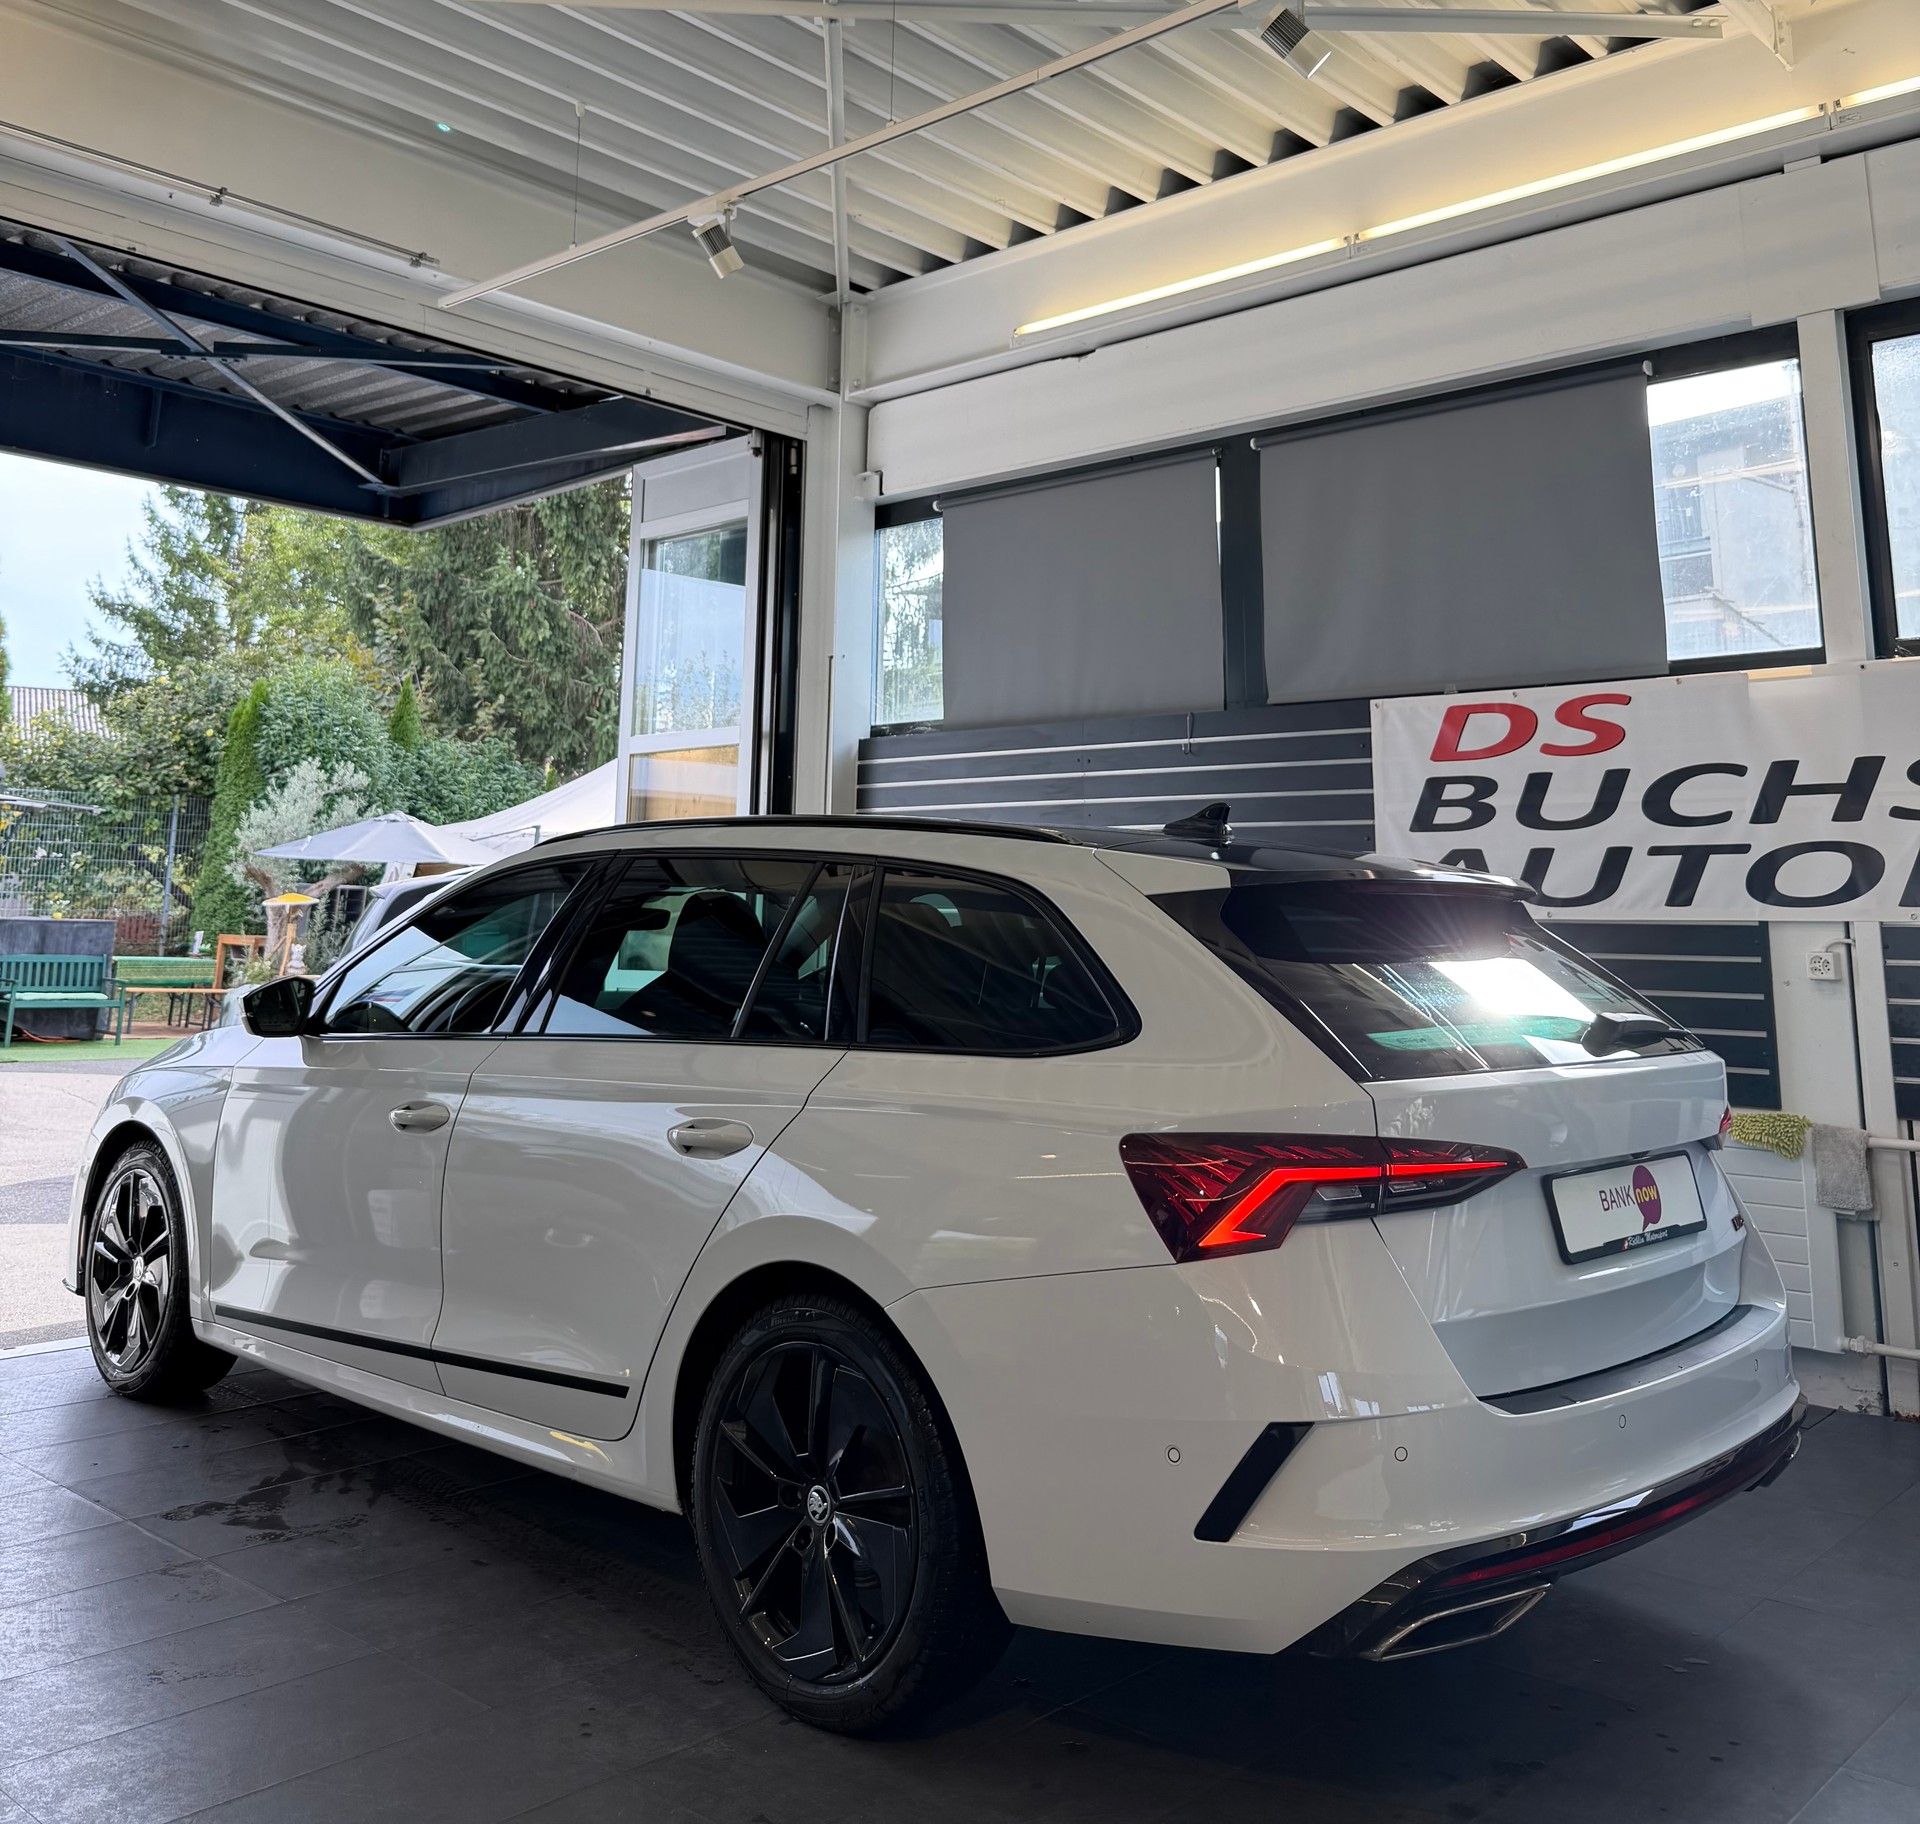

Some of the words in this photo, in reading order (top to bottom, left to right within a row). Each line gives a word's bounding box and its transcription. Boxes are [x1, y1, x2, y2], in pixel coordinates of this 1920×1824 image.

[1429, 693, 1632, 763] DS
[1438, 840, 1920, 909] UTO
[1599, 1185, 1636, 1212] BANK
[1635, 1185, 1658, 1204] now
